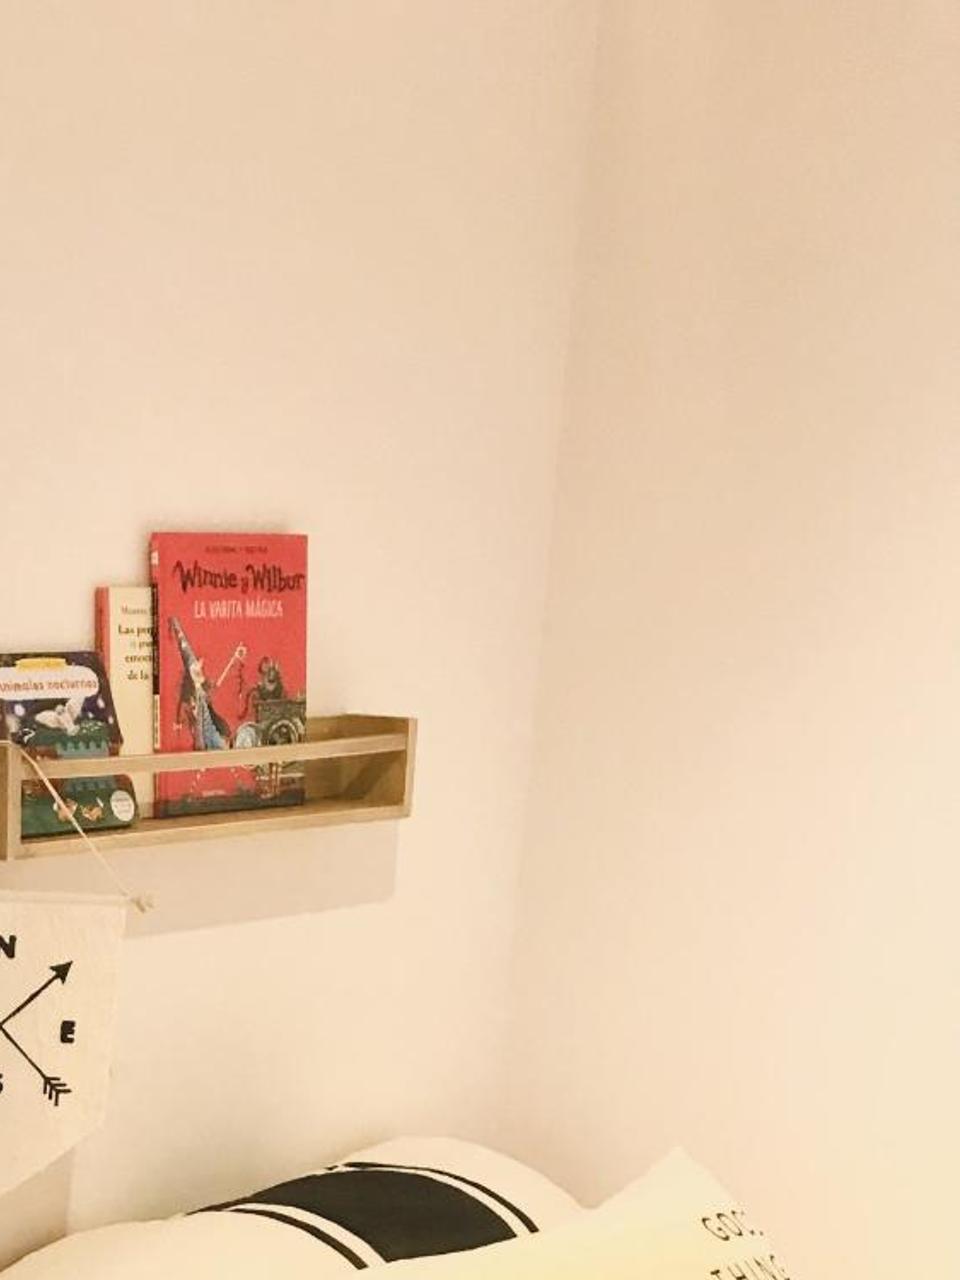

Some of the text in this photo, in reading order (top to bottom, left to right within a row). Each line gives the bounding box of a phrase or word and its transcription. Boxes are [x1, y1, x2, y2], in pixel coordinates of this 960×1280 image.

[172, 559, 239, 593] Winnie
[245, 562, 306, 593] Wilbur
[193, 599, 207, 619] LA
[60, 1020, 76, 1043] E
